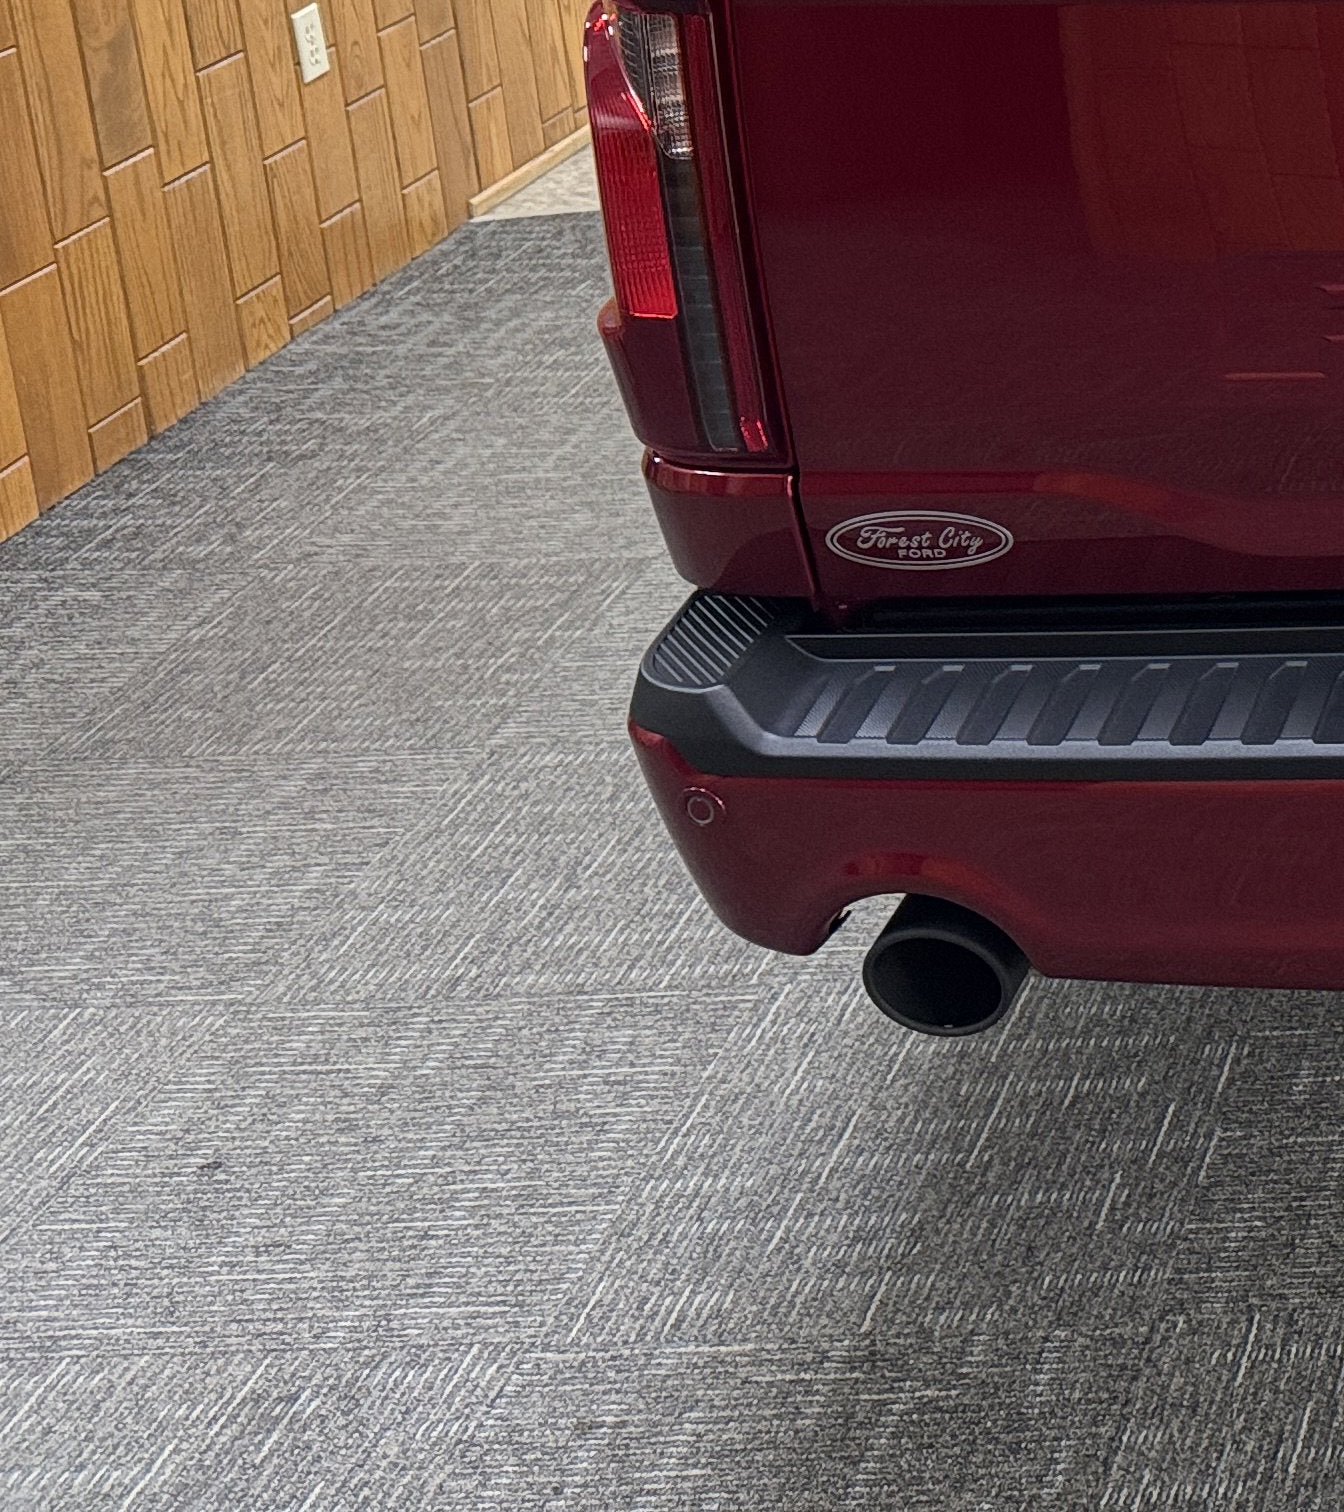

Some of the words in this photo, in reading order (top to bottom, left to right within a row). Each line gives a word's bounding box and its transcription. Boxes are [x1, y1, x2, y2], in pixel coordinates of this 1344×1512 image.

[856, 526, 931, 550] Forest
[938, 526, 984, 555] City
[897, 548, 947, 559] FORD
